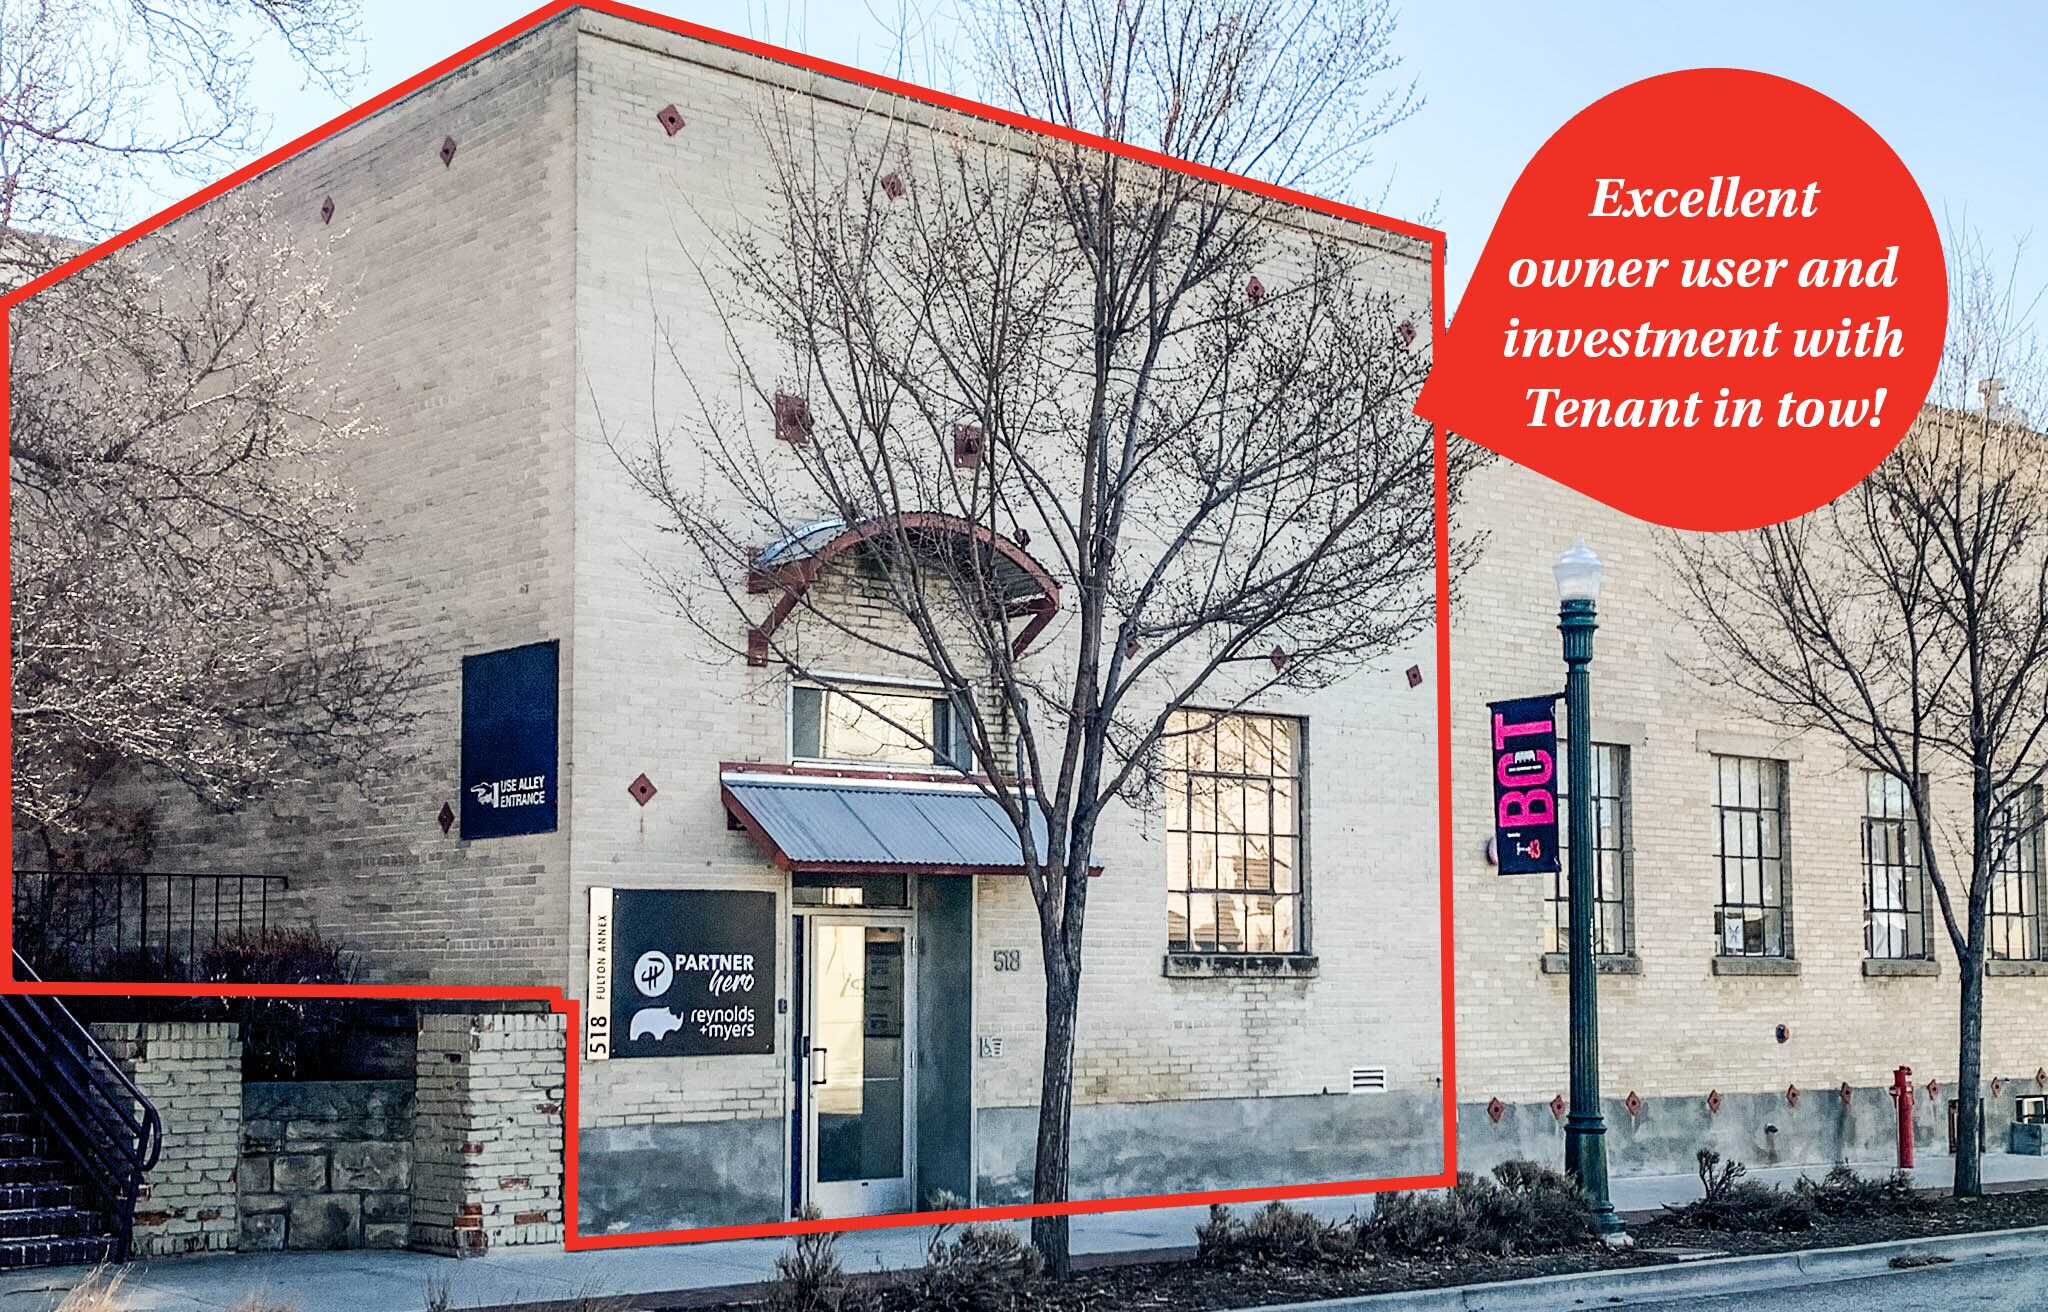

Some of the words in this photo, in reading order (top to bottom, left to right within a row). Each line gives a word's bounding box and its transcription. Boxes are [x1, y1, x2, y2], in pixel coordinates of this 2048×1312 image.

[501, 779, 517, 792] USE
[519, 776, 544, 790] ALLEY
[501, 791, 545, 807] ENTRANCE
[597, 915, 607, 952] ANNEX
[675, 954, 754, 971] PARTNER
[994, 950, 1019, 971] 518
[596, 957, 606, 1000] FULTON
[709, 970, 754, 996] hero
[691, 1006, 754, 1025] reynolds
[590, 1017, 606, 1053] 518
[700, 1024, 754, 1041] +myers
